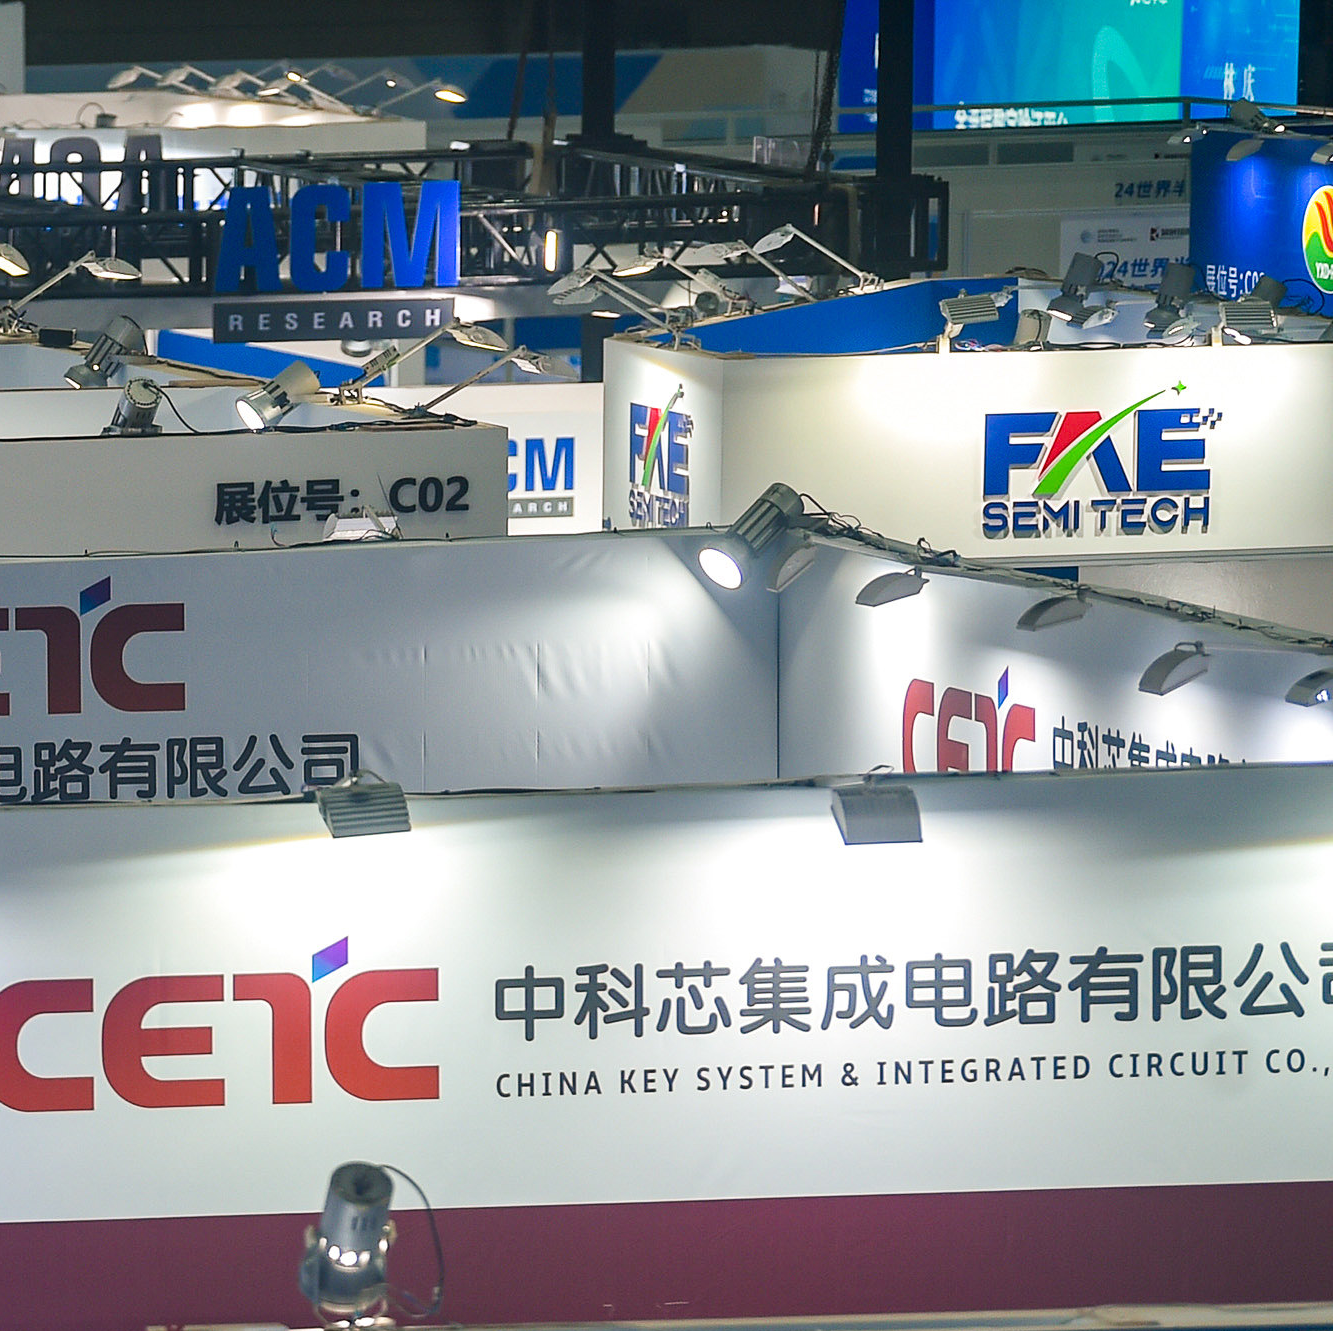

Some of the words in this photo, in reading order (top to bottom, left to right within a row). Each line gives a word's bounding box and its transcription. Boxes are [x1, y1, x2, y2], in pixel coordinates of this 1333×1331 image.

[215, 180, 460, 292] ACM
[228, 308, 442, 332] RESEARCH
[389, 476, 470, 513] C02
[983, 498, 1081, 537] SEMI
[1098, 497, 1210, 536] TECH
[493, 942, 1333, 1042] 中科芯集成电路有限公
[496, 1073, 604, 1099] CHINA
[619, 1066, 680, 1095] KEY
[696, 1062, 825, 1091] SYSTEM
[841, 1061, 861, 1087] &
[876, 1054, 1093, 1087] INTEGRATED
[1107, 1050, 1249, 1081] CIRCUIT
